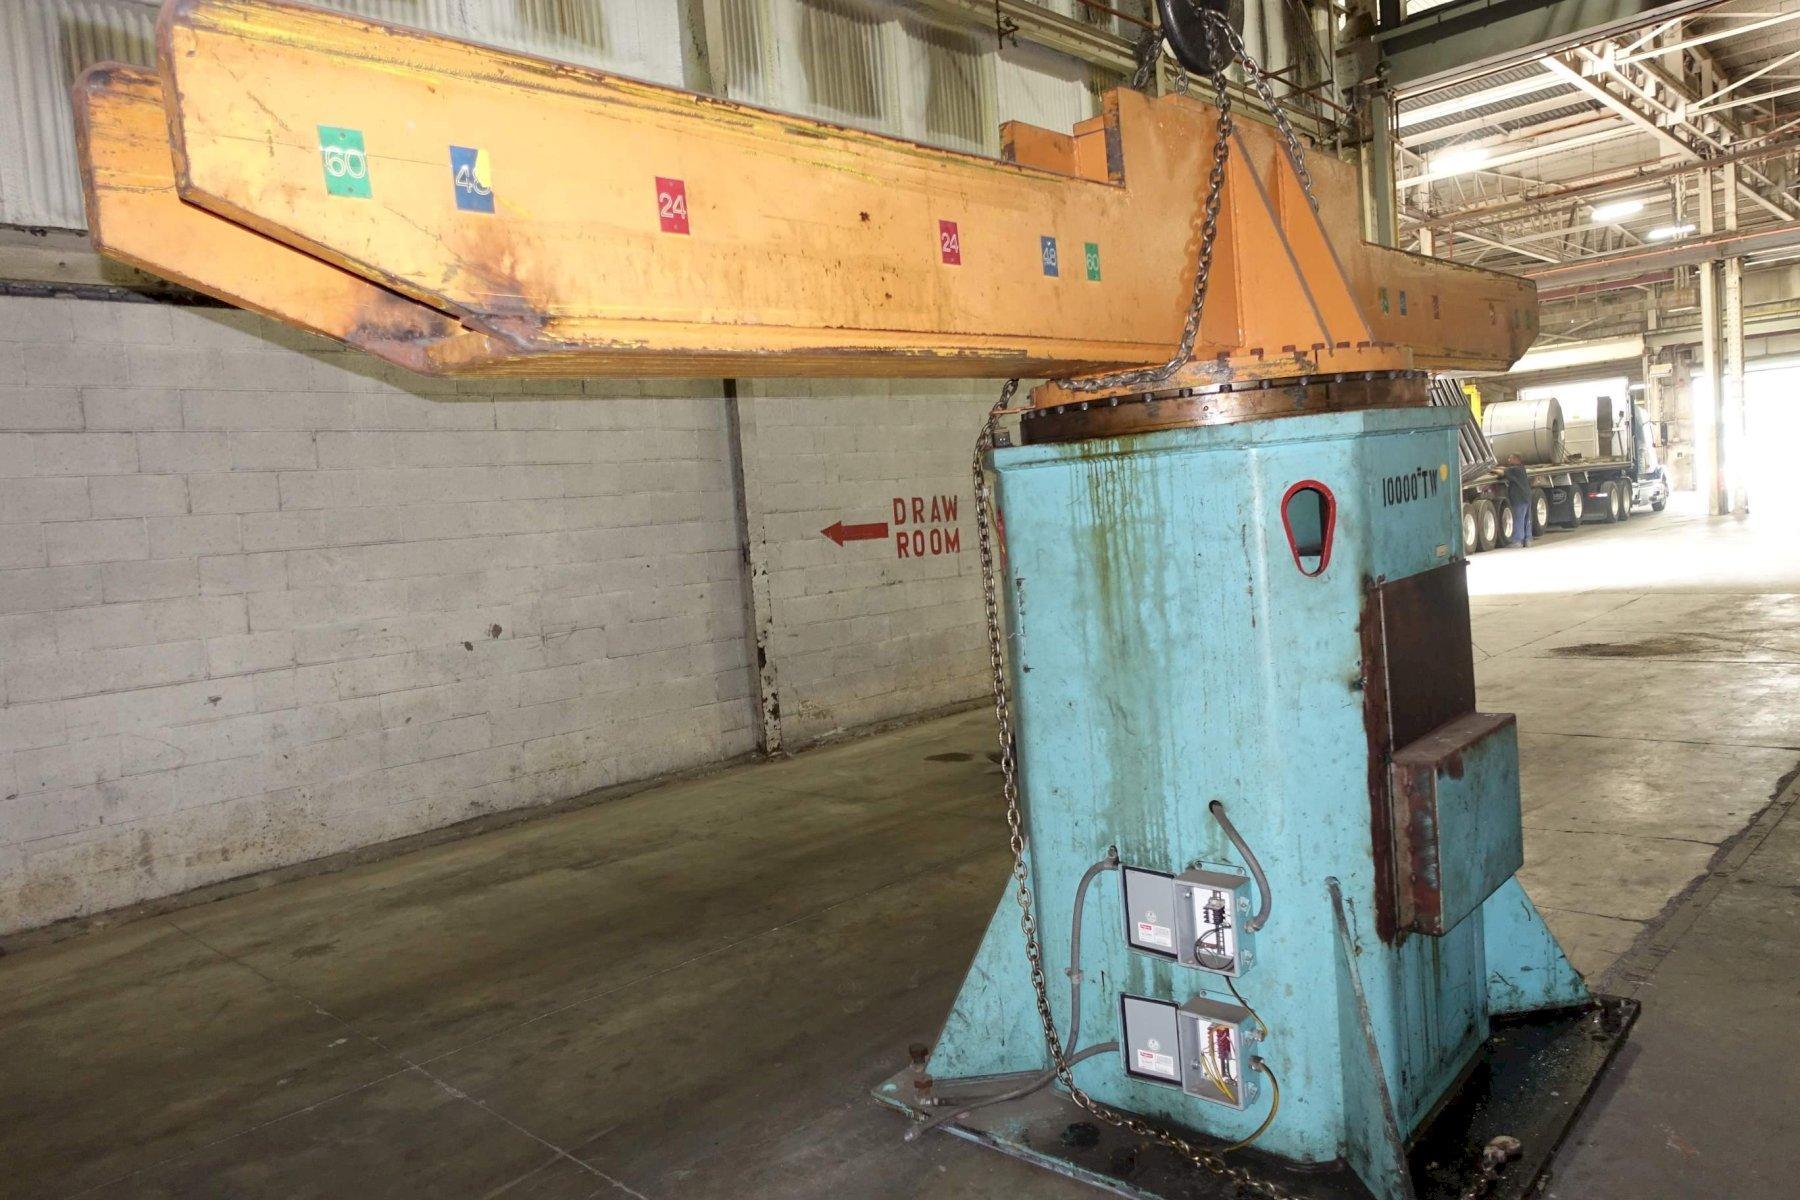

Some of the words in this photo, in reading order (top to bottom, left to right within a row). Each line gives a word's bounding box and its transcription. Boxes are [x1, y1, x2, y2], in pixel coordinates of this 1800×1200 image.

[325, 146, 366, 179] 60
[659, 192, 687, 220] 24
[941, 232, 959, 253] 24
[1043, 247, 1056, 266] 48
[1086, 253, 1099, 271] 60
[893, 494, 958, 525] DRAW
[896, 527, 960, 559] ROOM
